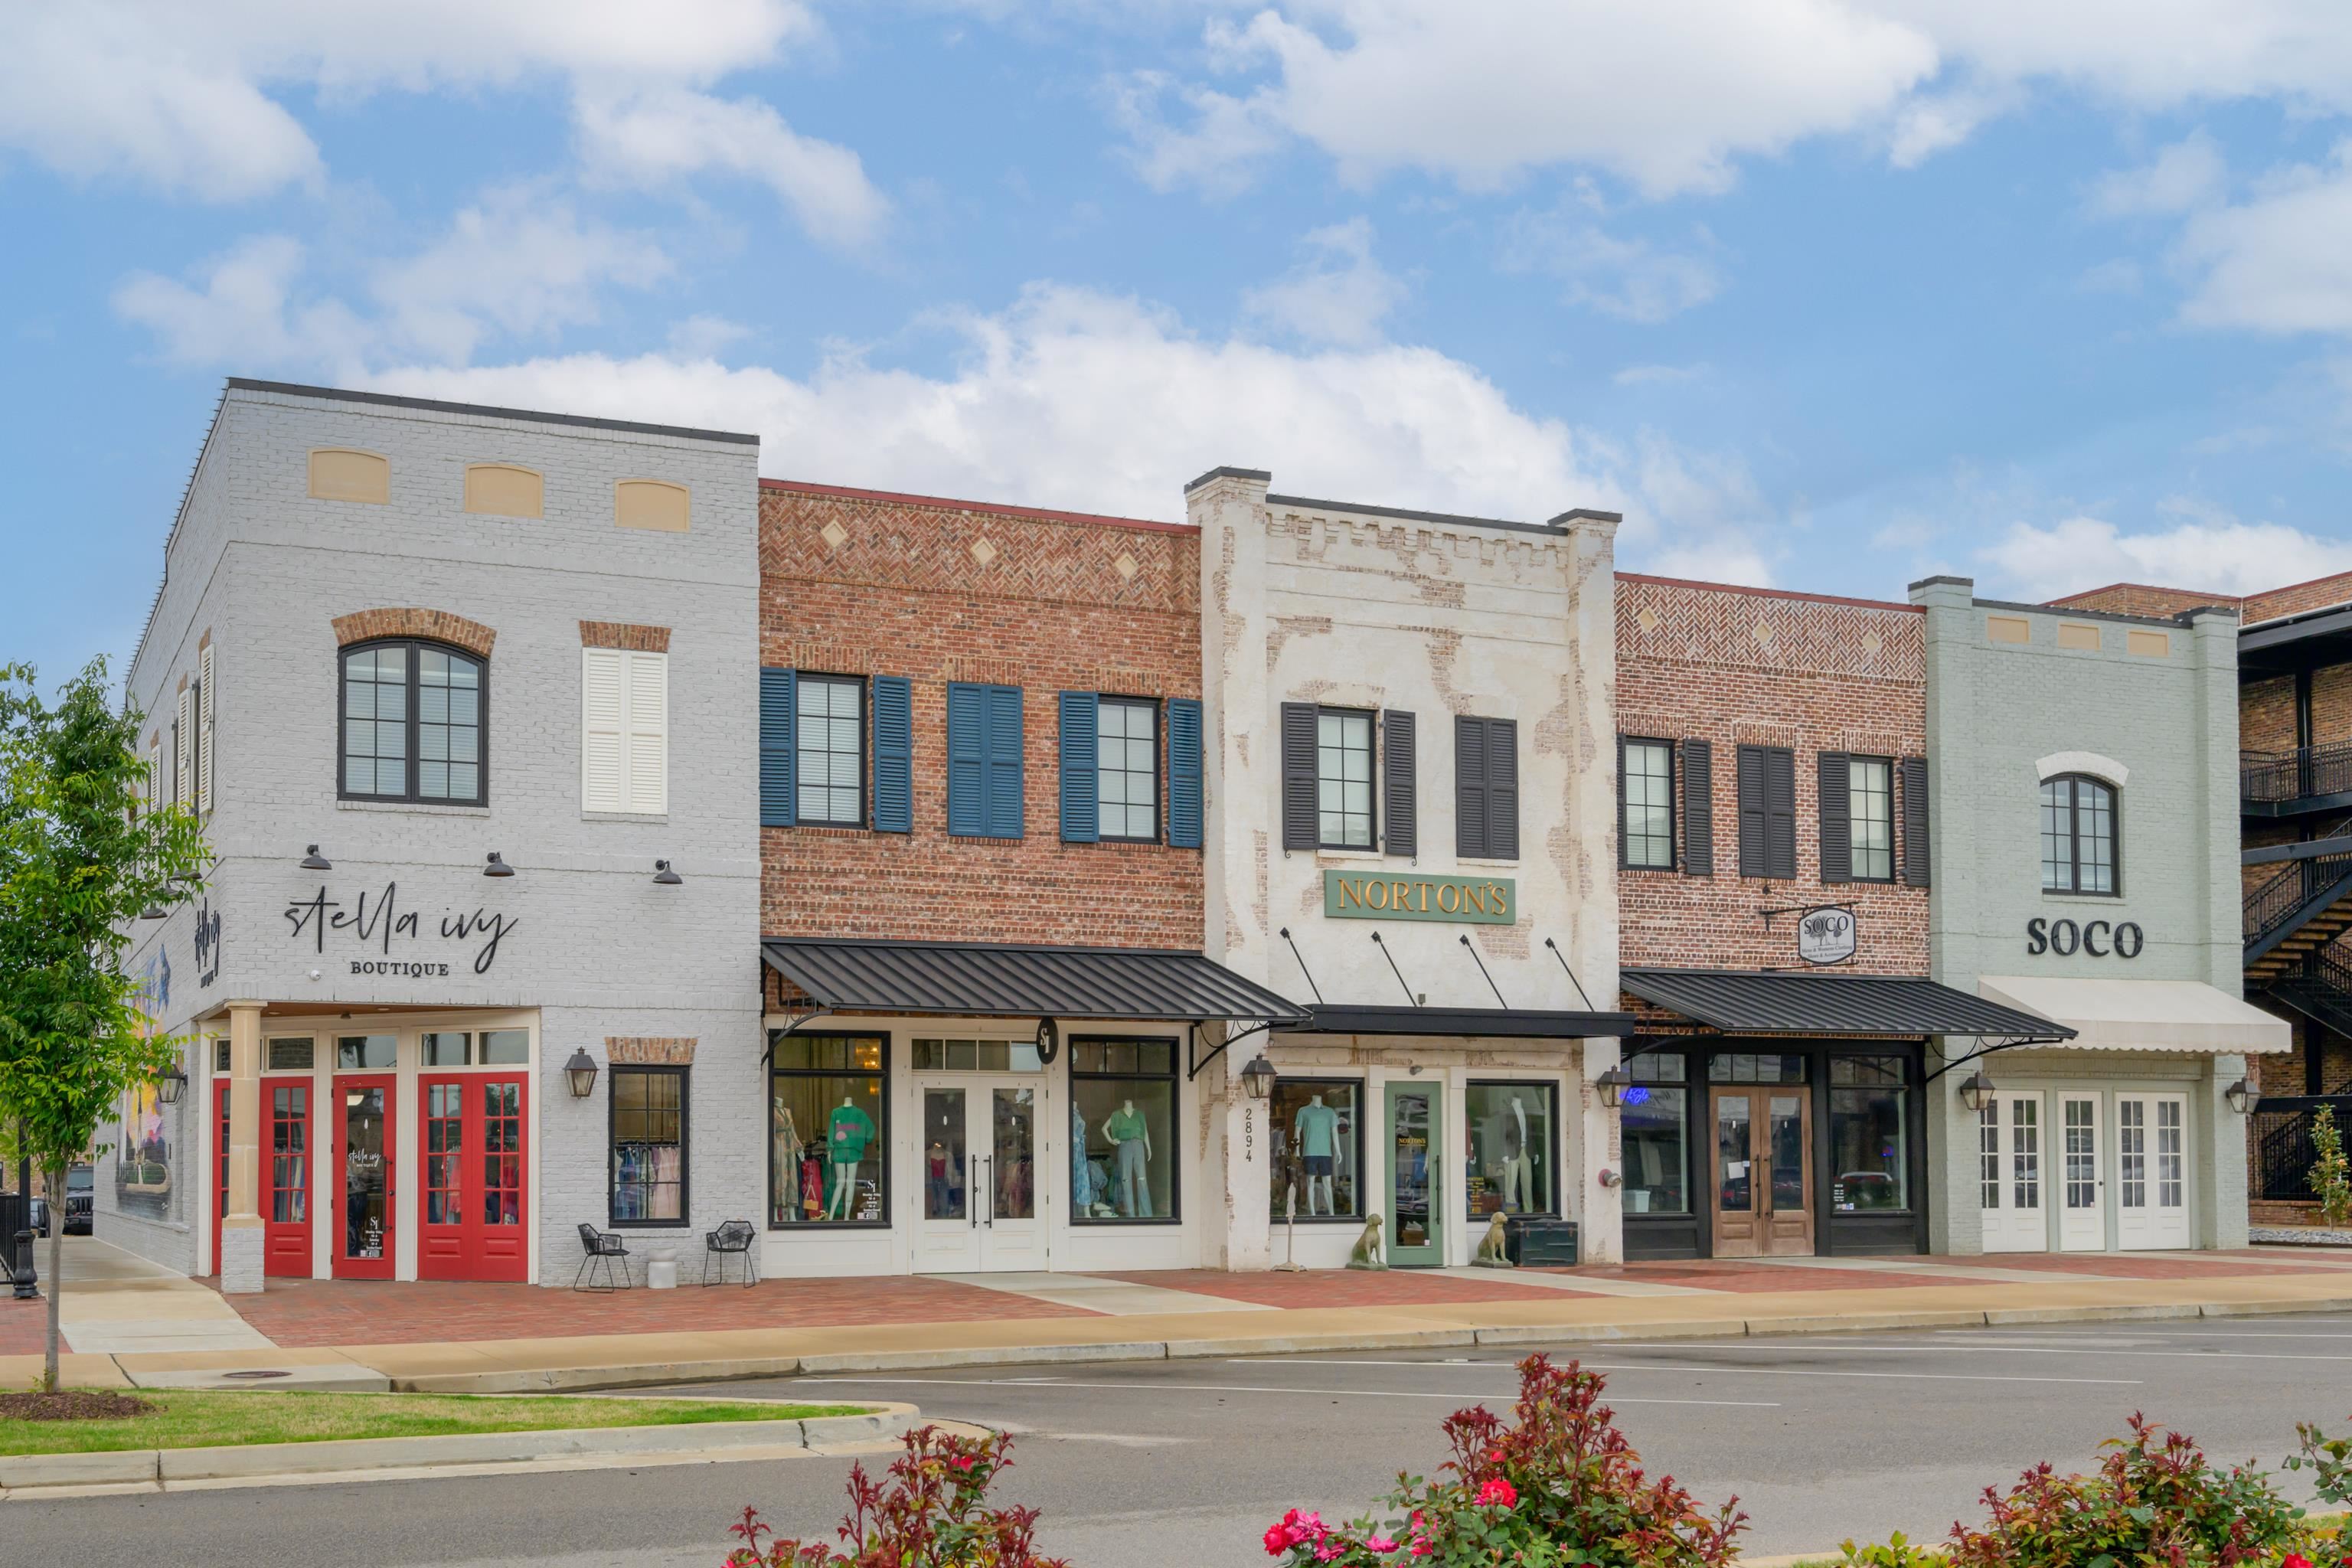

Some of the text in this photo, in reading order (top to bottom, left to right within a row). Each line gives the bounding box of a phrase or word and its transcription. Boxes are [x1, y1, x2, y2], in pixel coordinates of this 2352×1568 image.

[1338, 879, 1507, 916] NORTON'S
[284, 881, 519, 975] stella ivy
[1804, 916, 1848, 935] SOCO
[2027, 917, 2144, 959] SOCO
[351, 961, 449, 978] BOUTIQUE
[348, 1148, 368, 1164] stella
